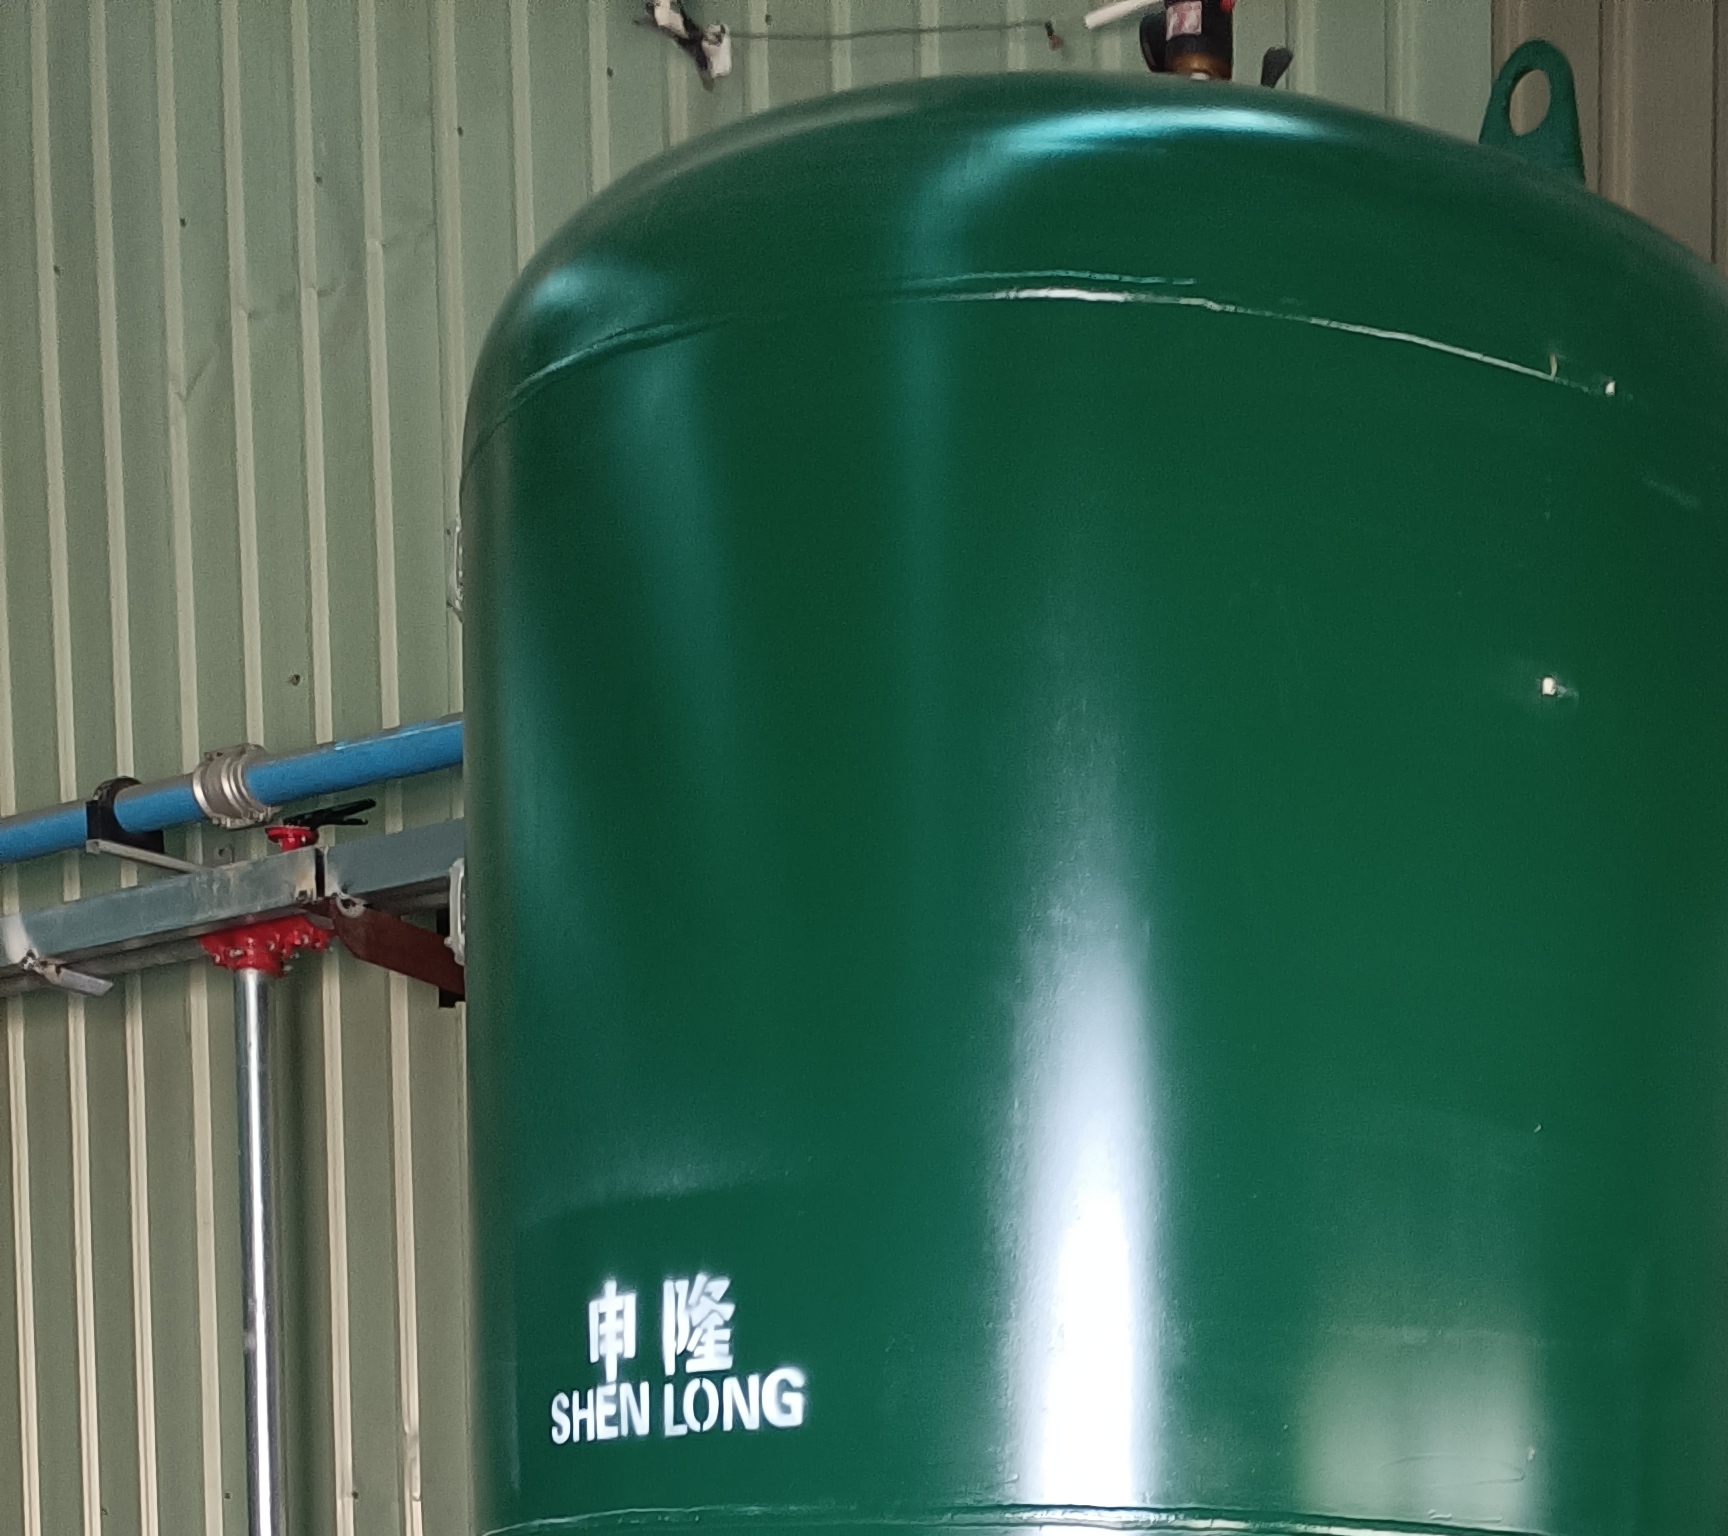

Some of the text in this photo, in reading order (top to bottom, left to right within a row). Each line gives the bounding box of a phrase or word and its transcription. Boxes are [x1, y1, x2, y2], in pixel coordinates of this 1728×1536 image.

[588, 1272, 735, 1382] 申隆
[551, 1366, 804, 1445] SHEN LONG
